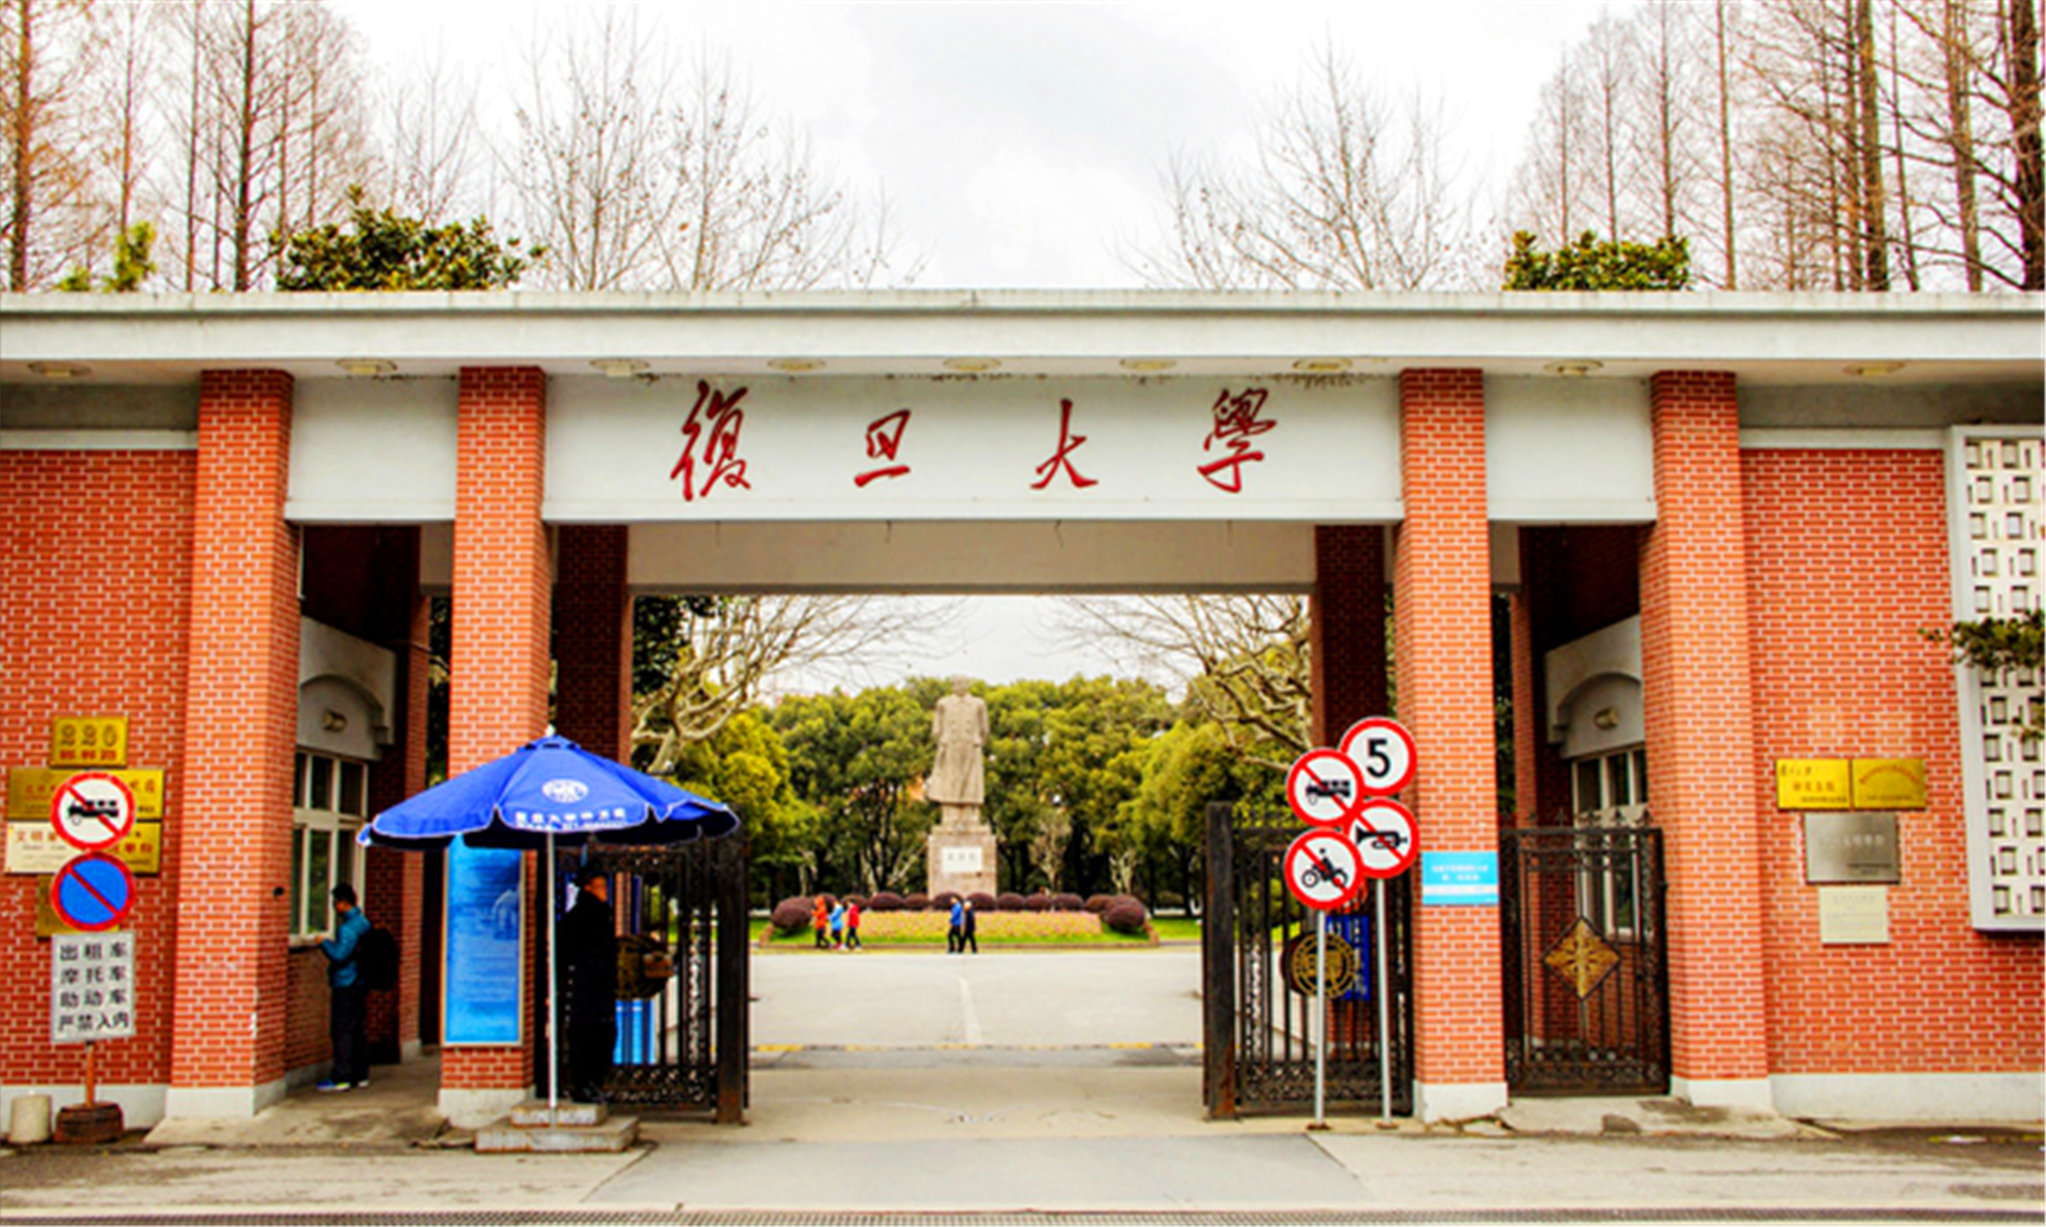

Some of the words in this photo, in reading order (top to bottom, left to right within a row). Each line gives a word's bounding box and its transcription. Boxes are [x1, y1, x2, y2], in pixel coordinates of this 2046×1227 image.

[1367, 738, 1391, 778] 5
[60, 966, 128, 985] 摩托车
